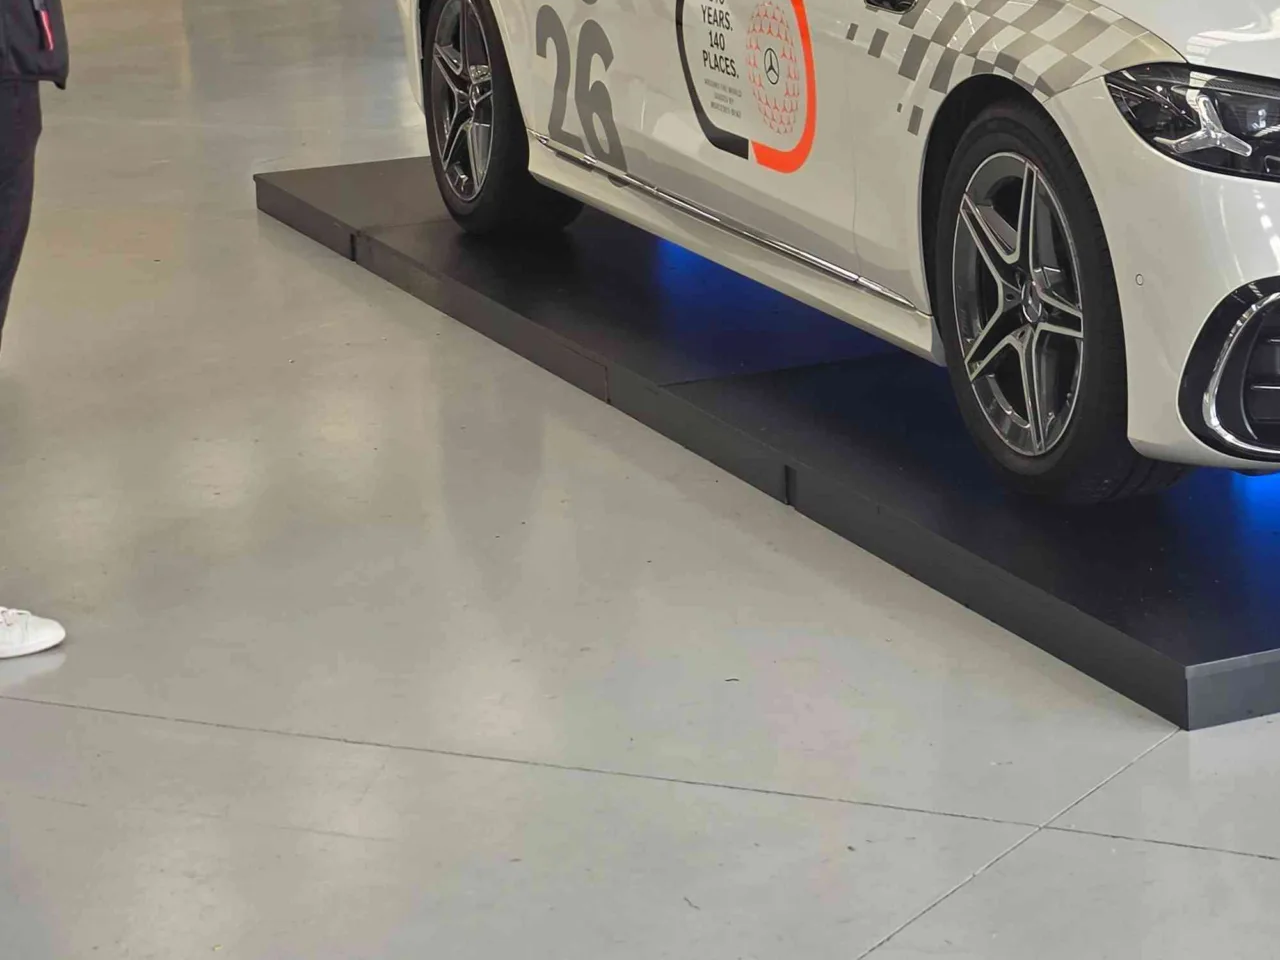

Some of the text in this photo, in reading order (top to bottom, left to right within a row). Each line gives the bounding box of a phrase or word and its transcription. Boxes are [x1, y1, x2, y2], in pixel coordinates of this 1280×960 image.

[701, 4, 733, 31] YEARS.
[708, 30, 725, 51] 140
[702, 49, 740, 79] PLACES.
[536, 4, 628, 171] 26
